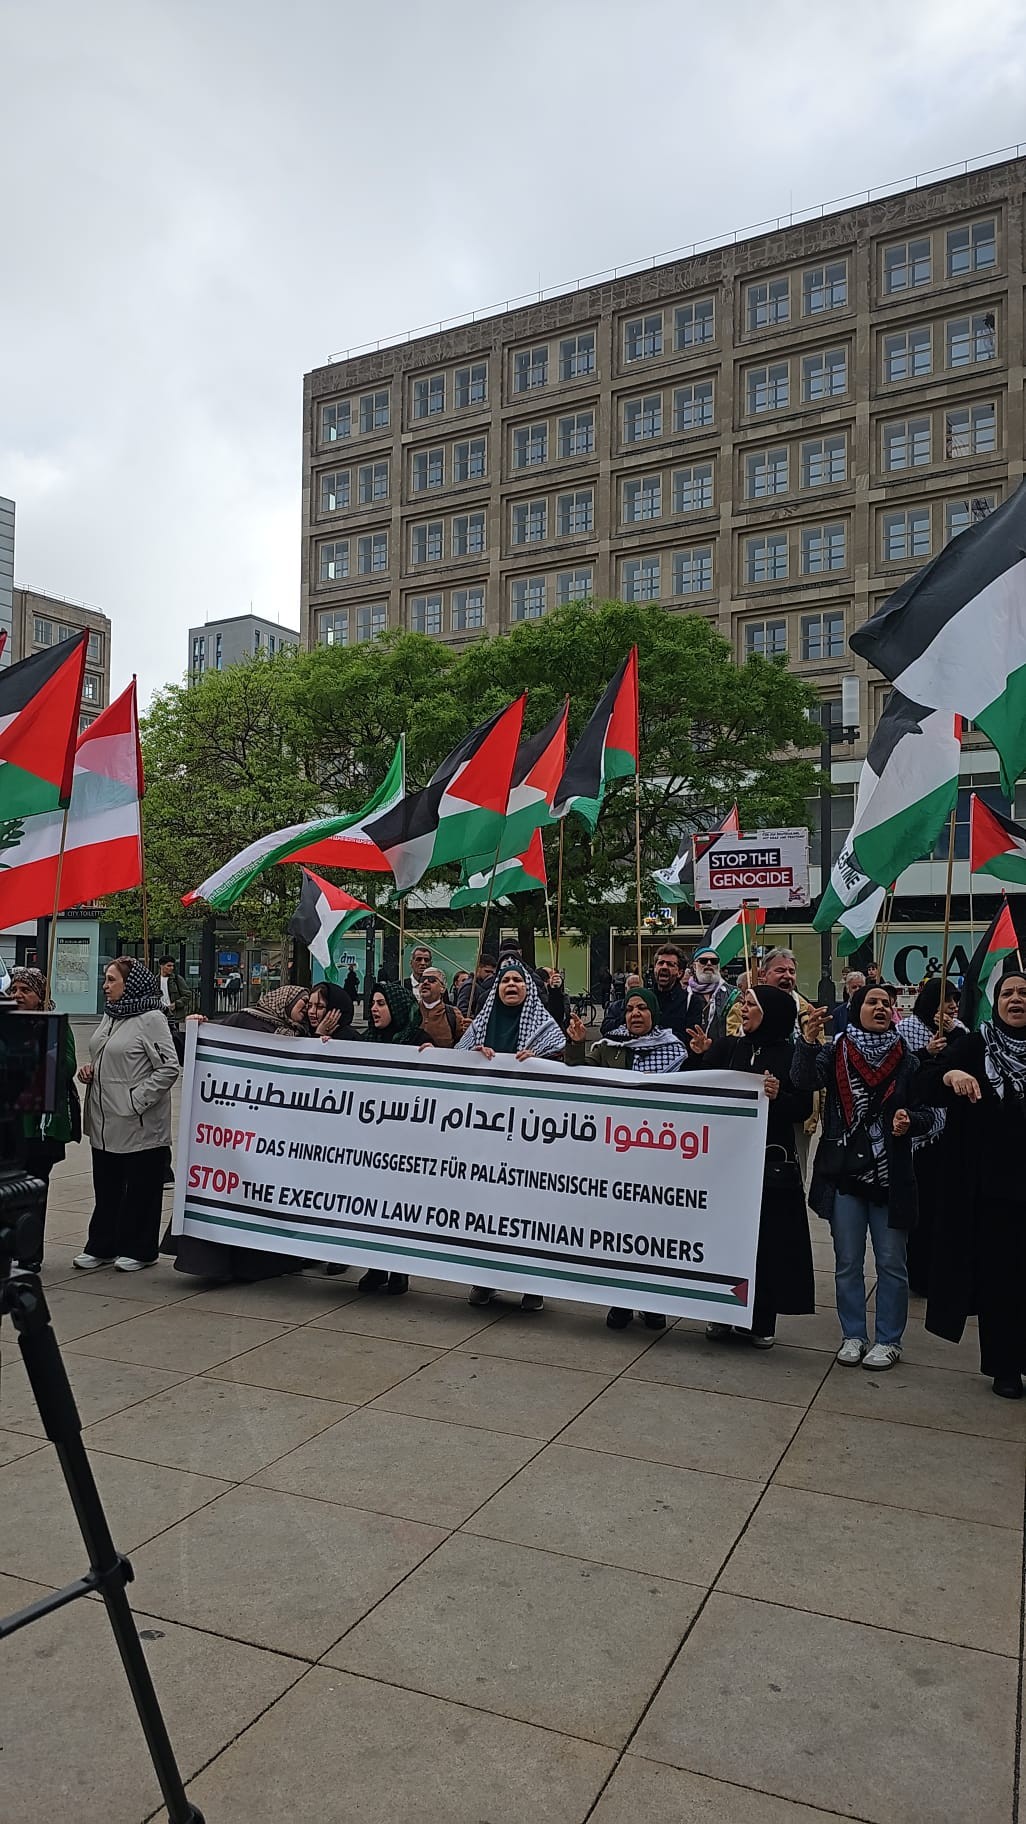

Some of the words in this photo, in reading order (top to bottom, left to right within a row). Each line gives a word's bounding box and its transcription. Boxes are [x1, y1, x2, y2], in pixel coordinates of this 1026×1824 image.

[711, 853, 747, 867] STOP
[749, 852, 778, 865] THE
[713, 871, 790, 887] GENOCIDE
[340, 952, 355, 964] dm
[893, 945, 972, 986] C&A
[200, 1073, 354, 1116] الفلسطينيين
[358, 1095, 437, 1126] الأسرى
[440, 1102, 515, 1141] إعدام
[521, 1108, 597, 1144] قانون
[604, 1116, 710, 1160] اوقفوا
[195, 1123, 256, 1152] STOPPT
[255, 1137, 285, 1157] DAS
[288, 1141, 437, 1176] HINRICHTUNGSGESETZ
[440, 1156, 467, 1180] FÜR
[470, 1162, 608, 1199] PALÄSTINENSISCHE
[612, 1181, 708, 1210] GEFANGENE
[187, 1164, 240, 1194] STOP
[242, 1181, 275, 1204] THE
[279, 1187, 378, 1218] EXECUTION
[381, 1200, 422, 1223] LAW
[426, 1206, 459, 1230] FOR
[465, 1211, 584, 1248] PALESTINIAN
[589, 1229, 704, 1264] PRISONERS
